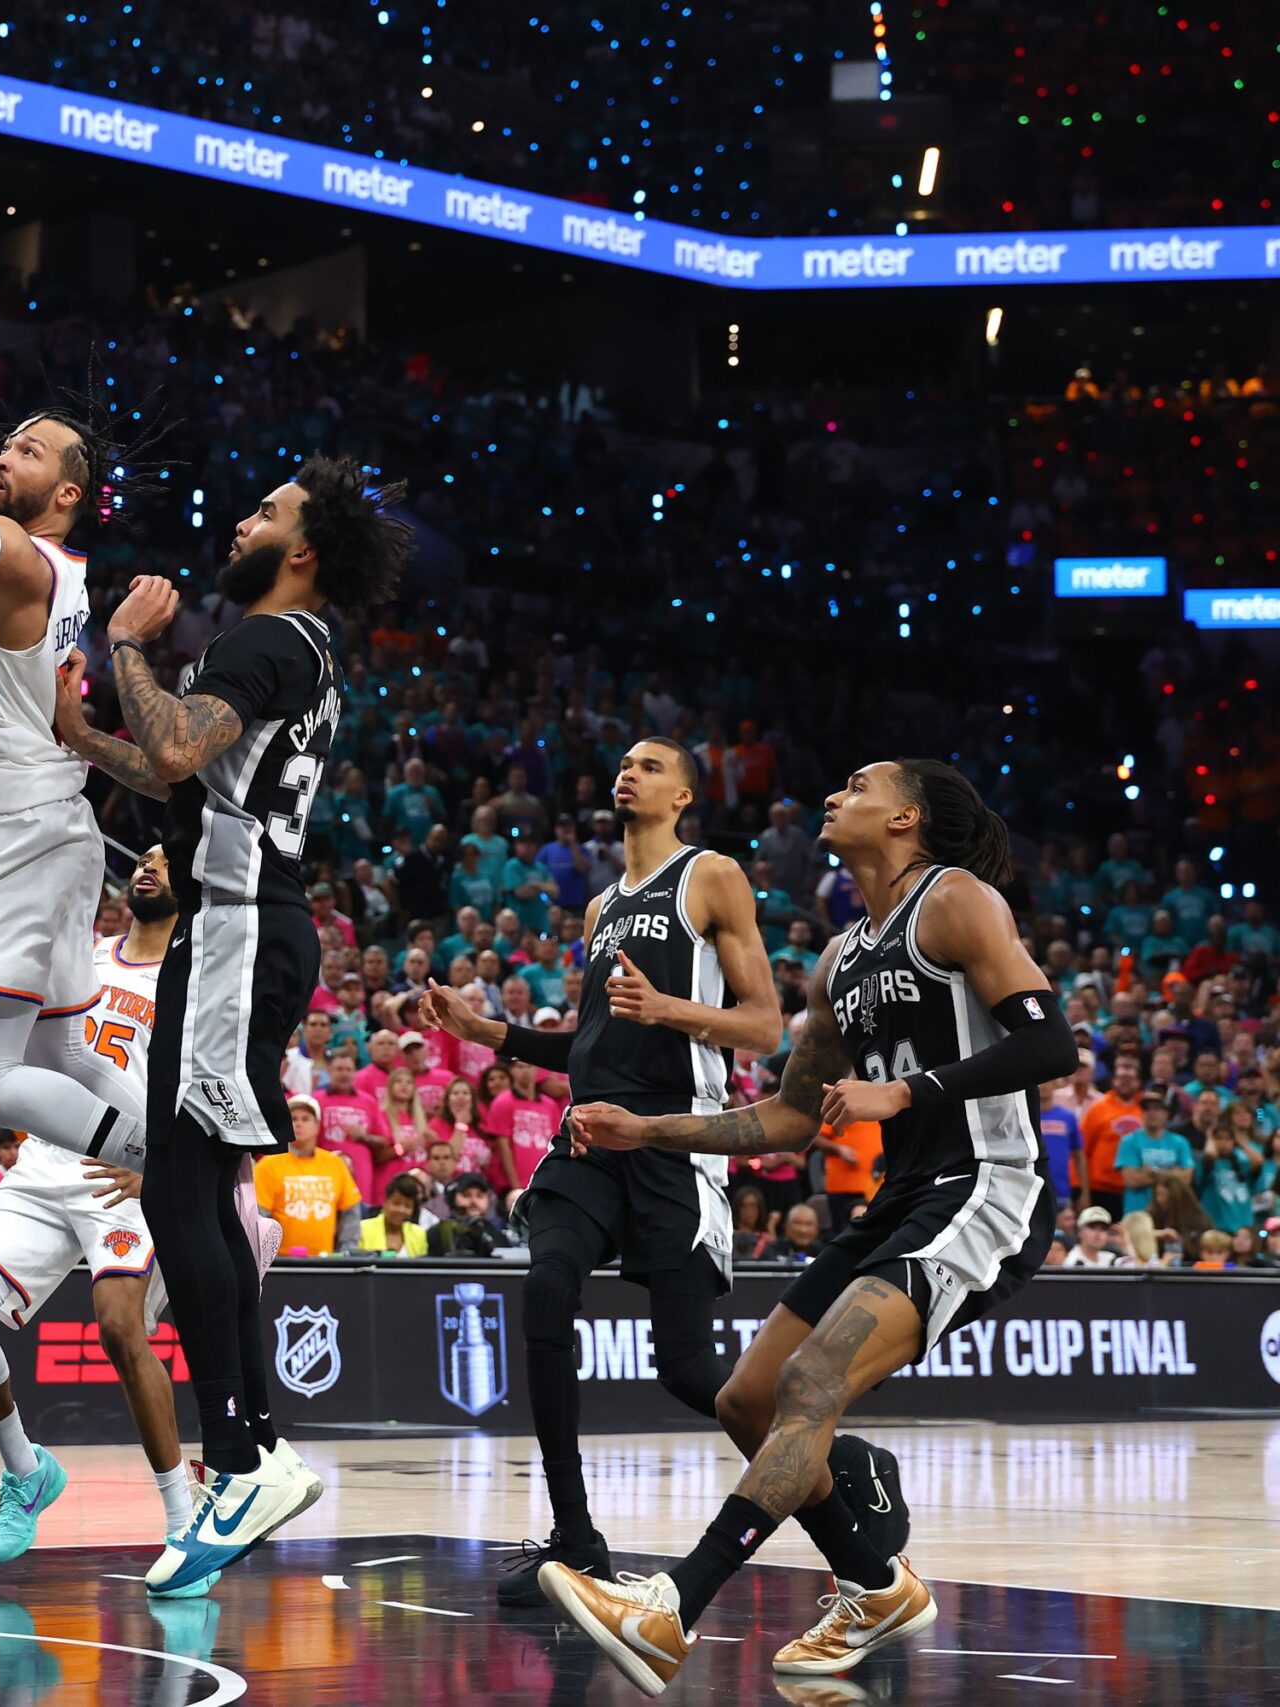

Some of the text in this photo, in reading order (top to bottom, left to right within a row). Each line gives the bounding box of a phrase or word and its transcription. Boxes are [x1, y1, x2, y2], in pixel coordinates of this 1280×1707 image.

[60, 104, 159, 152] meter
[195, 133, 290, 181] meter
[323, 161, 414, 207] meter
[445, 188, 533, 233] meter
[563, 213, 646, 257] meter
[955, 238, 1068, 275] meter
[1110, 234, 1223, 272] meter
[674, 238, 762, 279] meter
[803, 243, 914, 278] meter
[1072, 562, 1151, 589] meter
[1211, 593, 1280, 620] mete
[266, 752, 325, 861] 3
[106, 985, 156, 1032] YORK
[833, 969, 921, 1037] SPURS
[291, 1330, 327, 1376] NHL
[573, 1318, 659, 1381] OME
[1004, 1319, 1084, 1377] CUP
[1090, 1319, 1197, 1376] FINAL
